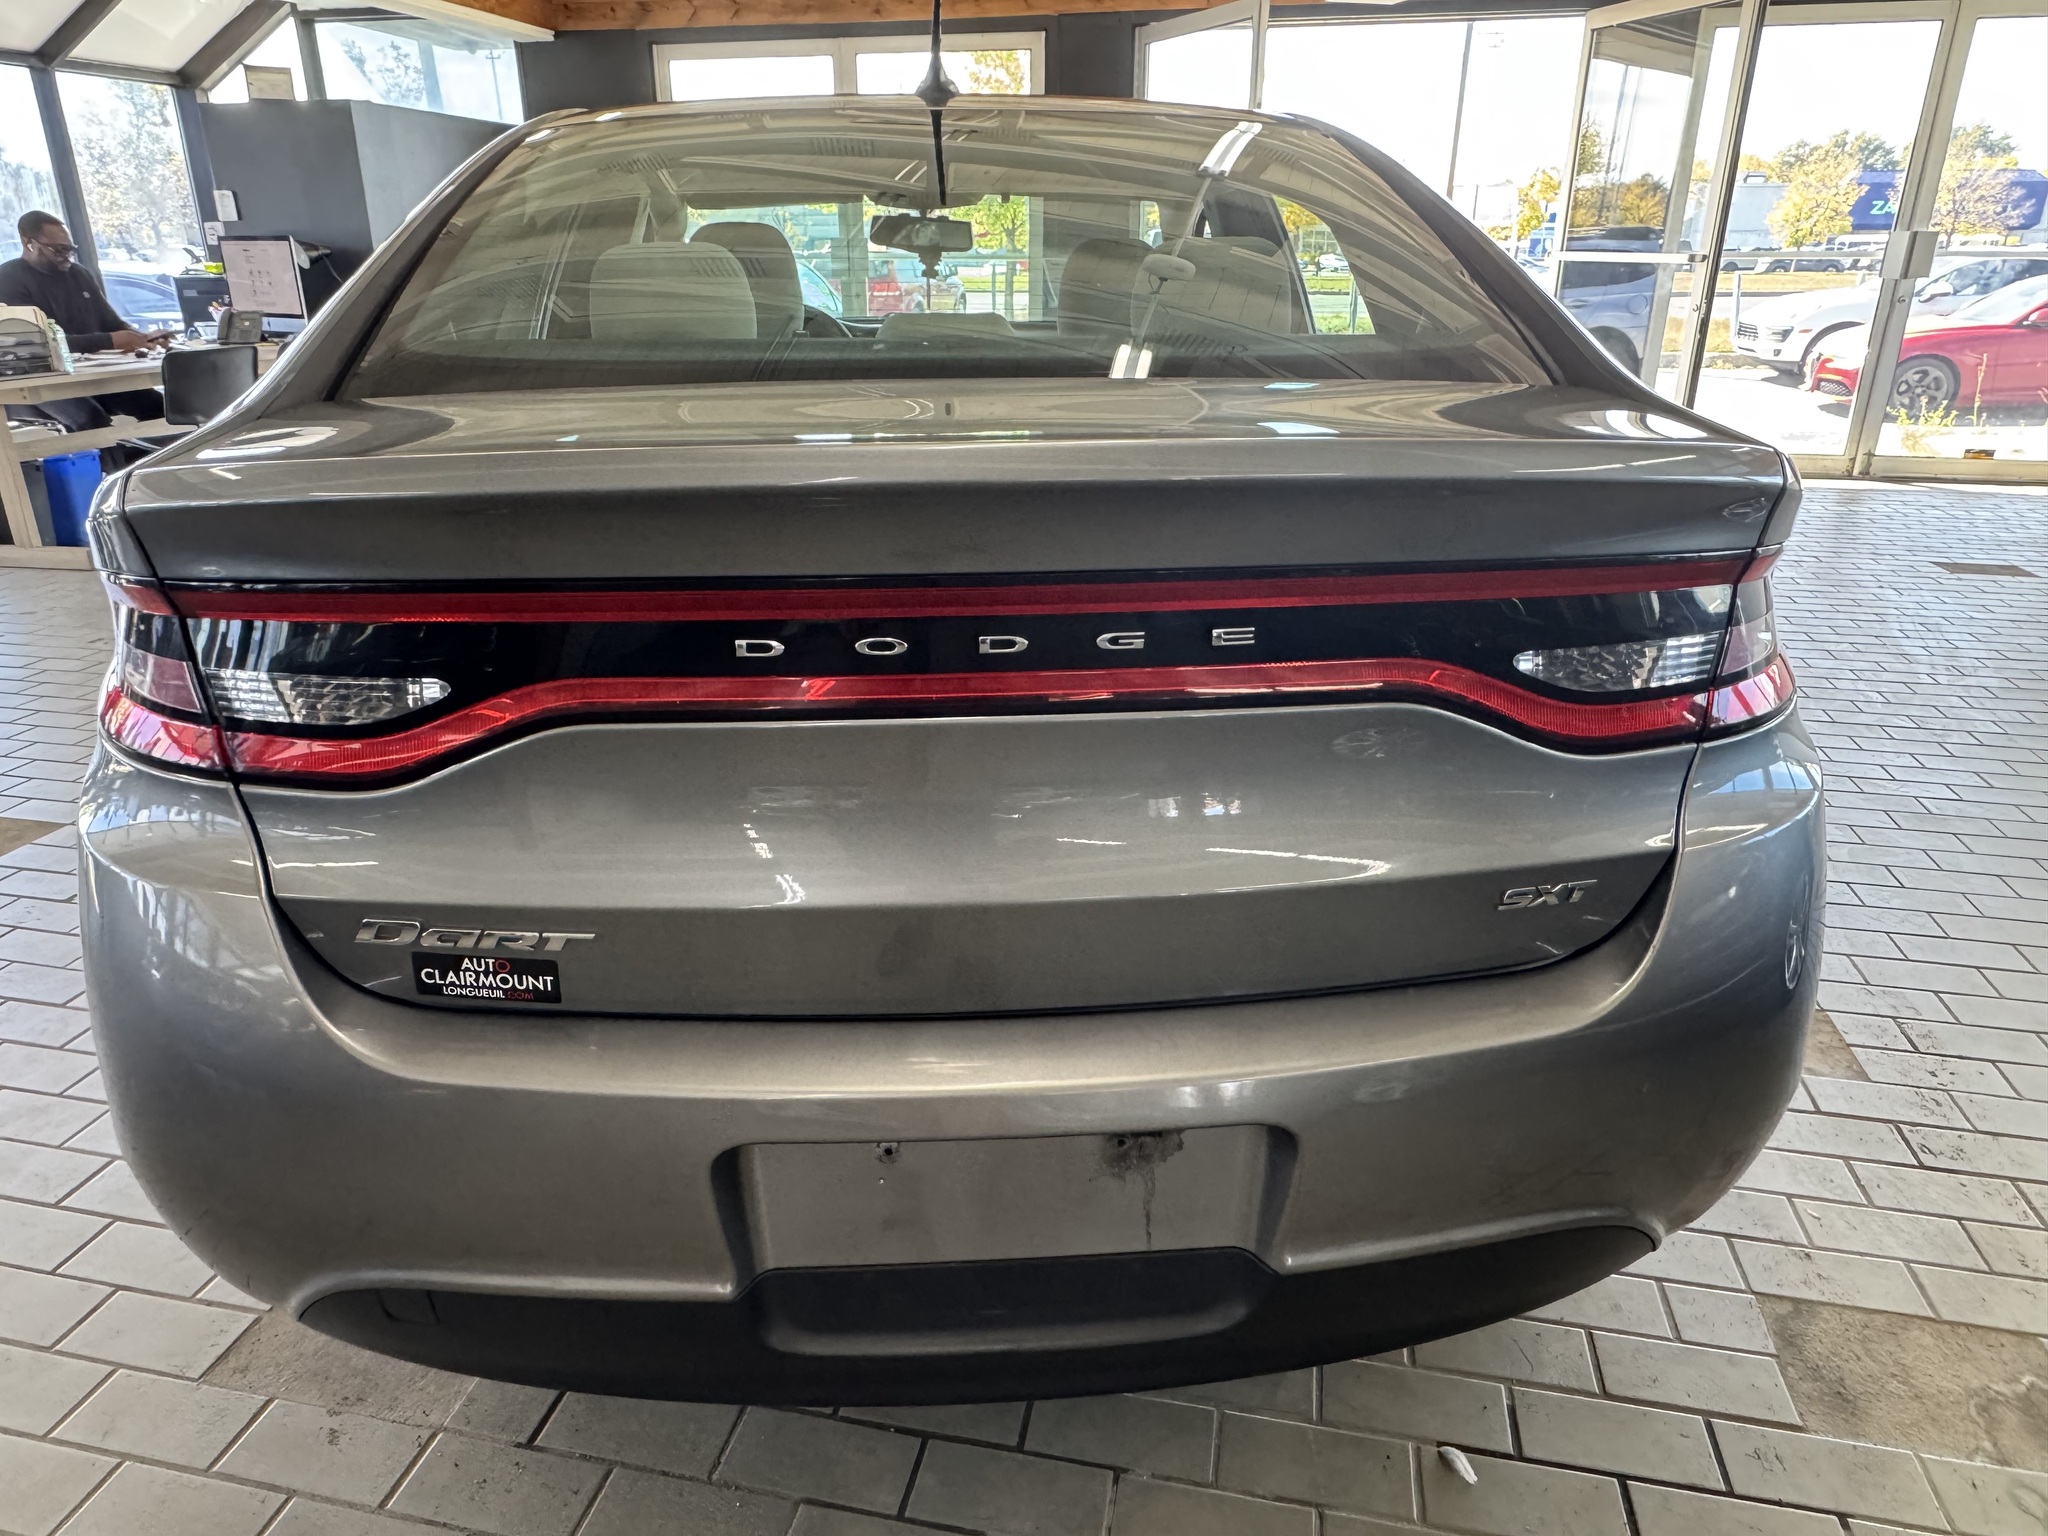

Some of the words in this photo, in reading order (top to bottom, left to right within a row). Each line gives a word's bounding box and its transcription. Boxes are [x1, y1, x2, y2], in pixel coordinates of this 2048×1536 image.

[1870, 200, 1896, 214] ZA
[735, 627, 1255, 657] DODGE
[1497, 879, 1598, 911] SXT
[461, 957, 511, 973] AUTO
[420, 968, 554, 991] CLAIRMOUNT
